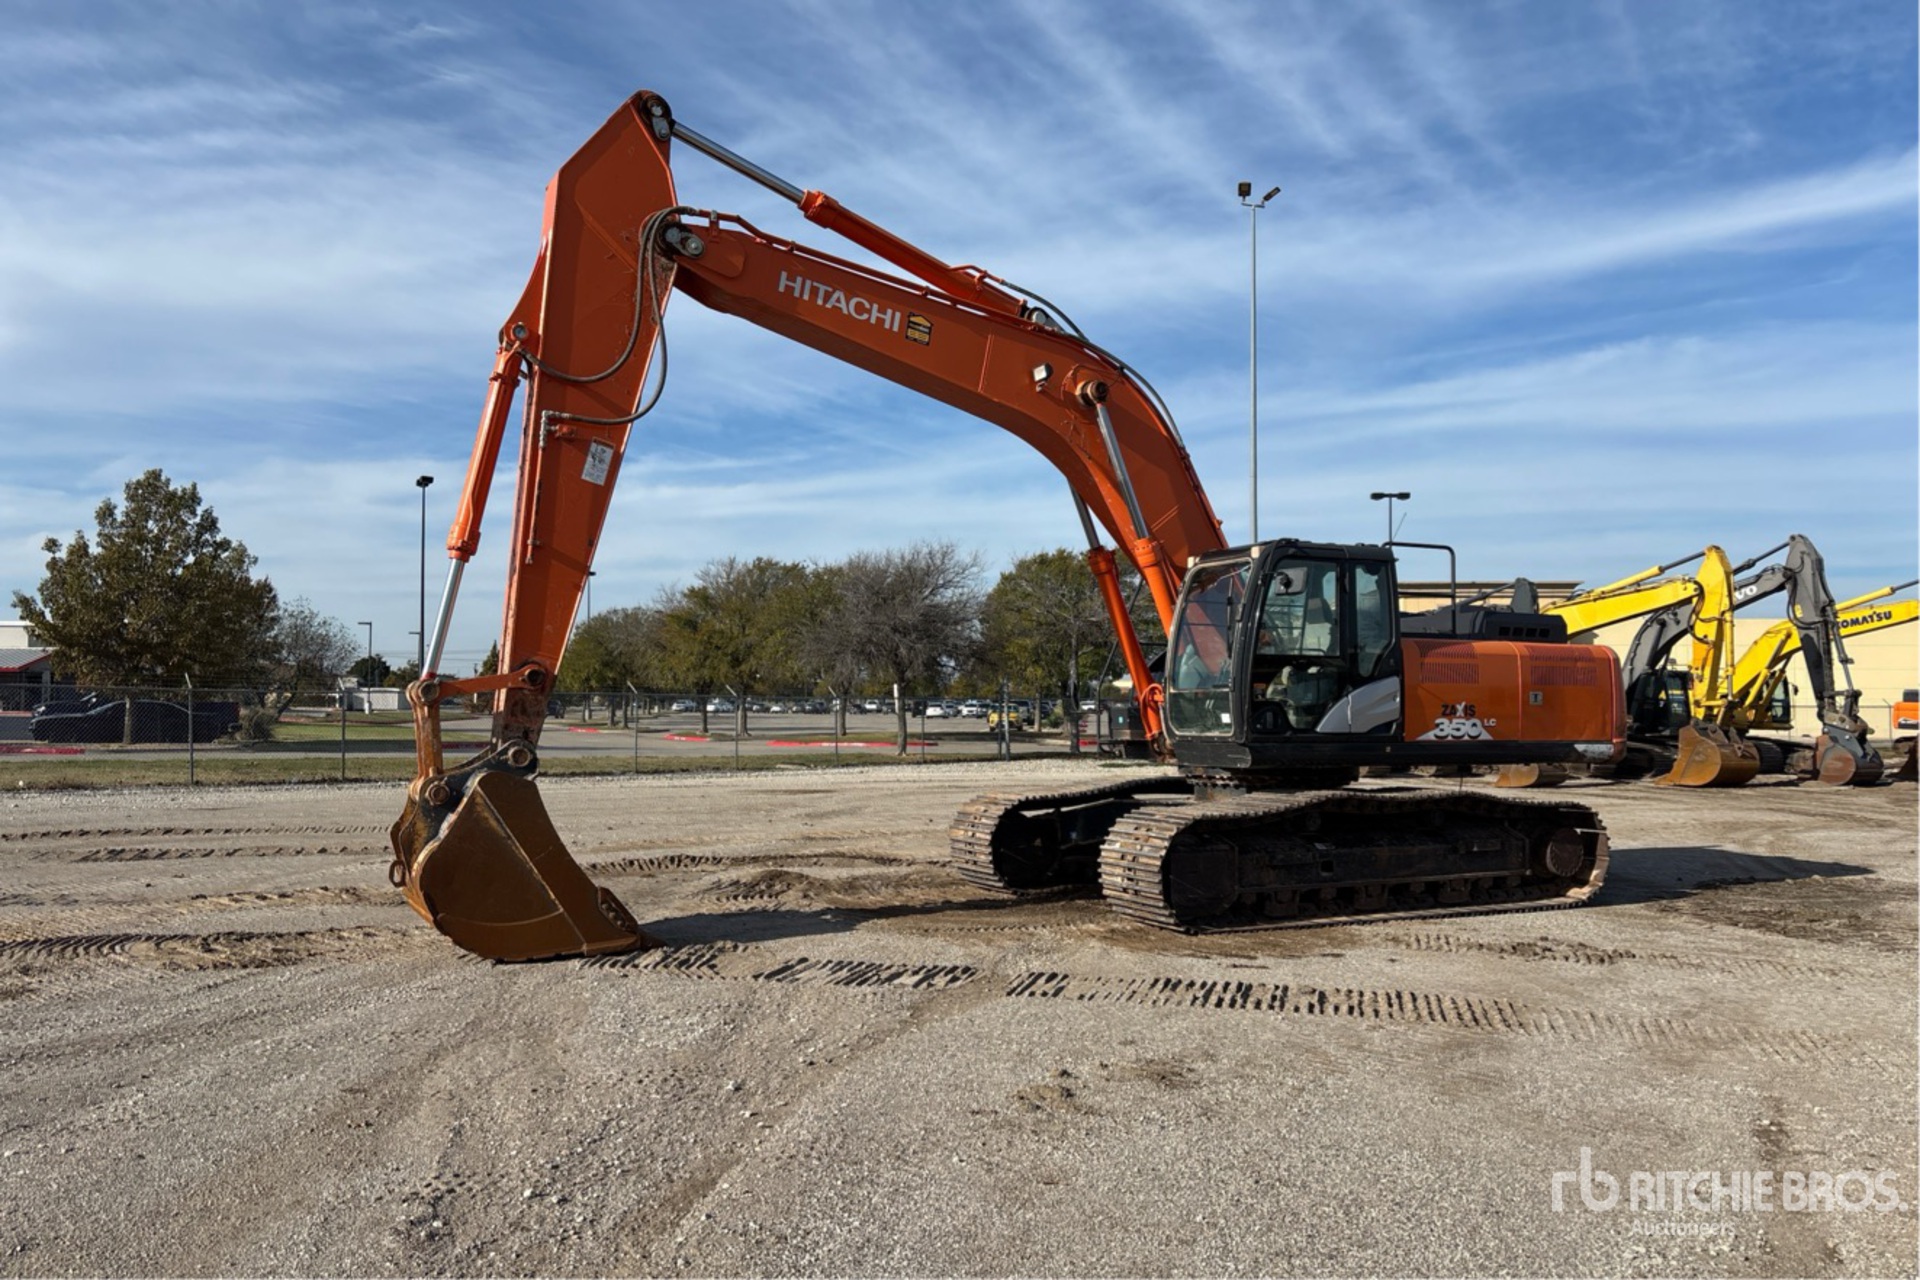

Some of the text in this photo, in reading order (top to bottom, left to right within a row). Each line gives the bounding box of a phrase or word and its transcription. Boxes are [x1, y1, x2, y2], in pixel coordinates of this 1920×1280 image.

[778, 271, 901, 332] HITACHI
[1837, 610, 1892, 629] OMATSU
[1441, 701, 1476, 717] ZAXIS
[1434, 717, 1497, 739] 350 LC
